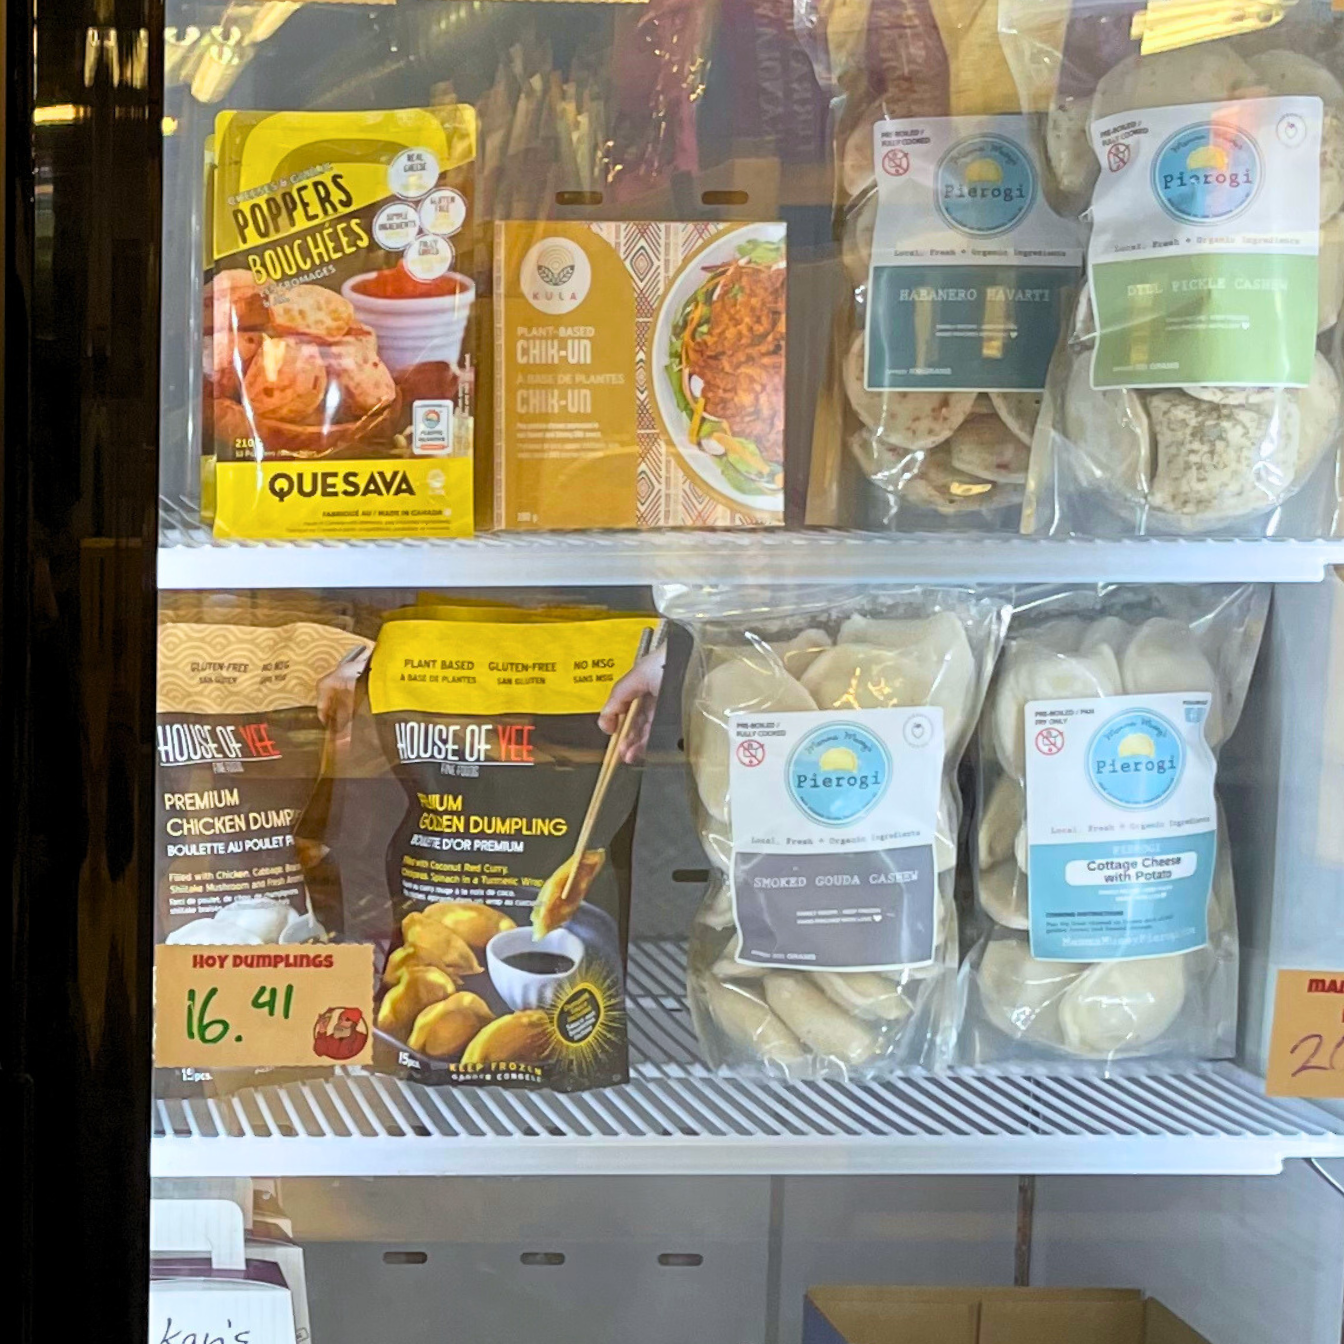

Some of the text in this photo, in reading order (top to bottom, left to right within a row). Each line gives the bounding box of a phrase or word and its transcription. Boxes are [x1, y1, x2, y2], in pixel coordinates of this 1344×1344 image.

[232, 173, 354, 245] POPPERS
[247, 218, 370, 285] BOUCHÉES
[899, 288, 1050, 301] HABANERO HAVARTI
[517, 326, 595, 338] PLANT-BASED
[268, 470, 416, 502] QUESAVA
[403, 658, 476, 672] PLANT BASED
[488, 660, 557, 674] GLUTEN-FREE
[573, 658, 615, 672] NO MSG
[157, 722, 281, 764] HOUSE YEE
[395, 721, 536, 763] HOUSE OF YEE
[1096, 755, 1177, 775] Pierogi
[796, 770, 882, 789] Pierogi
[164, 788, 240, 811] PREMIUM
[166, 813, 246, 837] CHICKEN
[469, 815, 568, 836] DUMPLING
[166, 836, 284, 857] BOULETTE AU POULET
[442, 838, 471, 851] D'OR
[473, 839, 524, 853] PREMIUM
[1087, 854, 1182, 873] Cottage Cheese
[753, 870, 919, 888] SMOKED GOUDA CASHEW
[1103, 868, 1172, 883] with Potato
[186, 984, 295, 1046] 16.41
